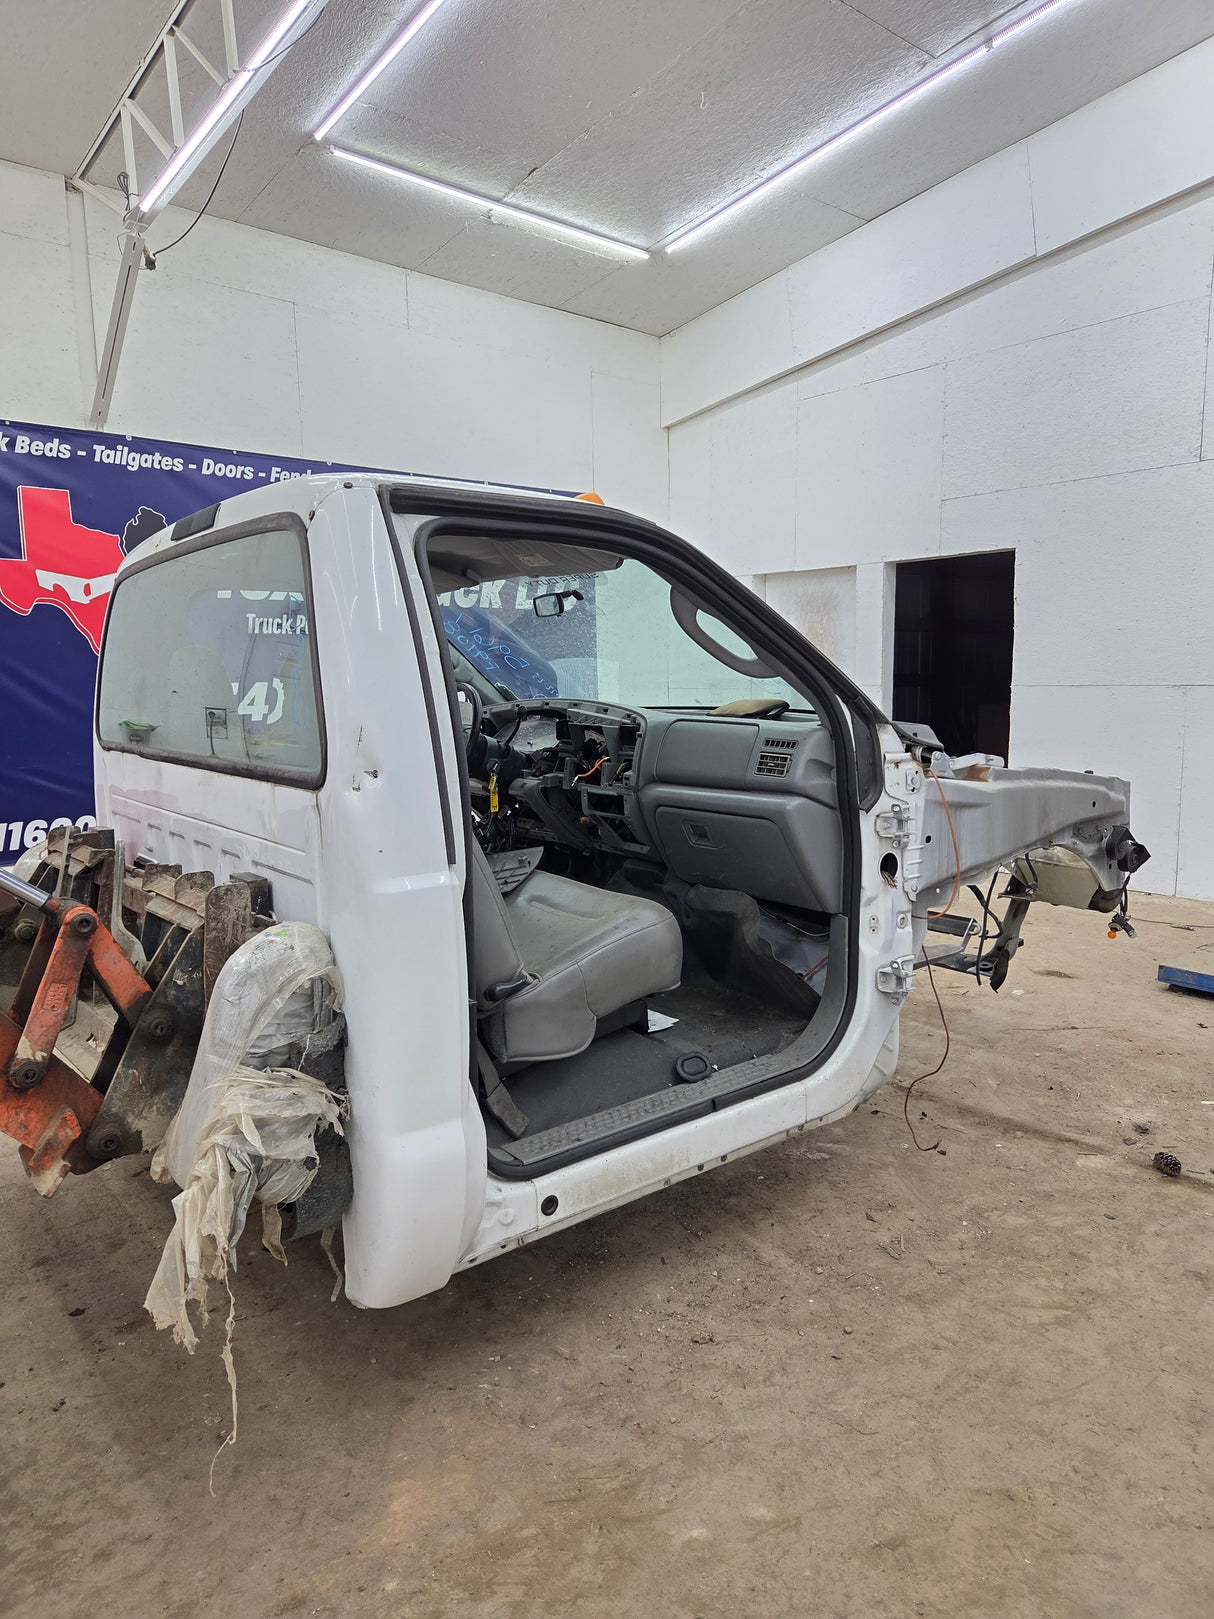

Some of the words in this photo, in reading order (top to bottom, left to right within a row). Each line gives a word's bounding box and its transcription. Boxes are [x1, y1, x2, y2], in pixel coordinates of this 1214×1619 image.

[14, 435, 72, 459] Beds
[92, 444, 184, 471] Tailgates
[201, 458, 254, 480] Doors
[246, 613, 293, 635] Truck
